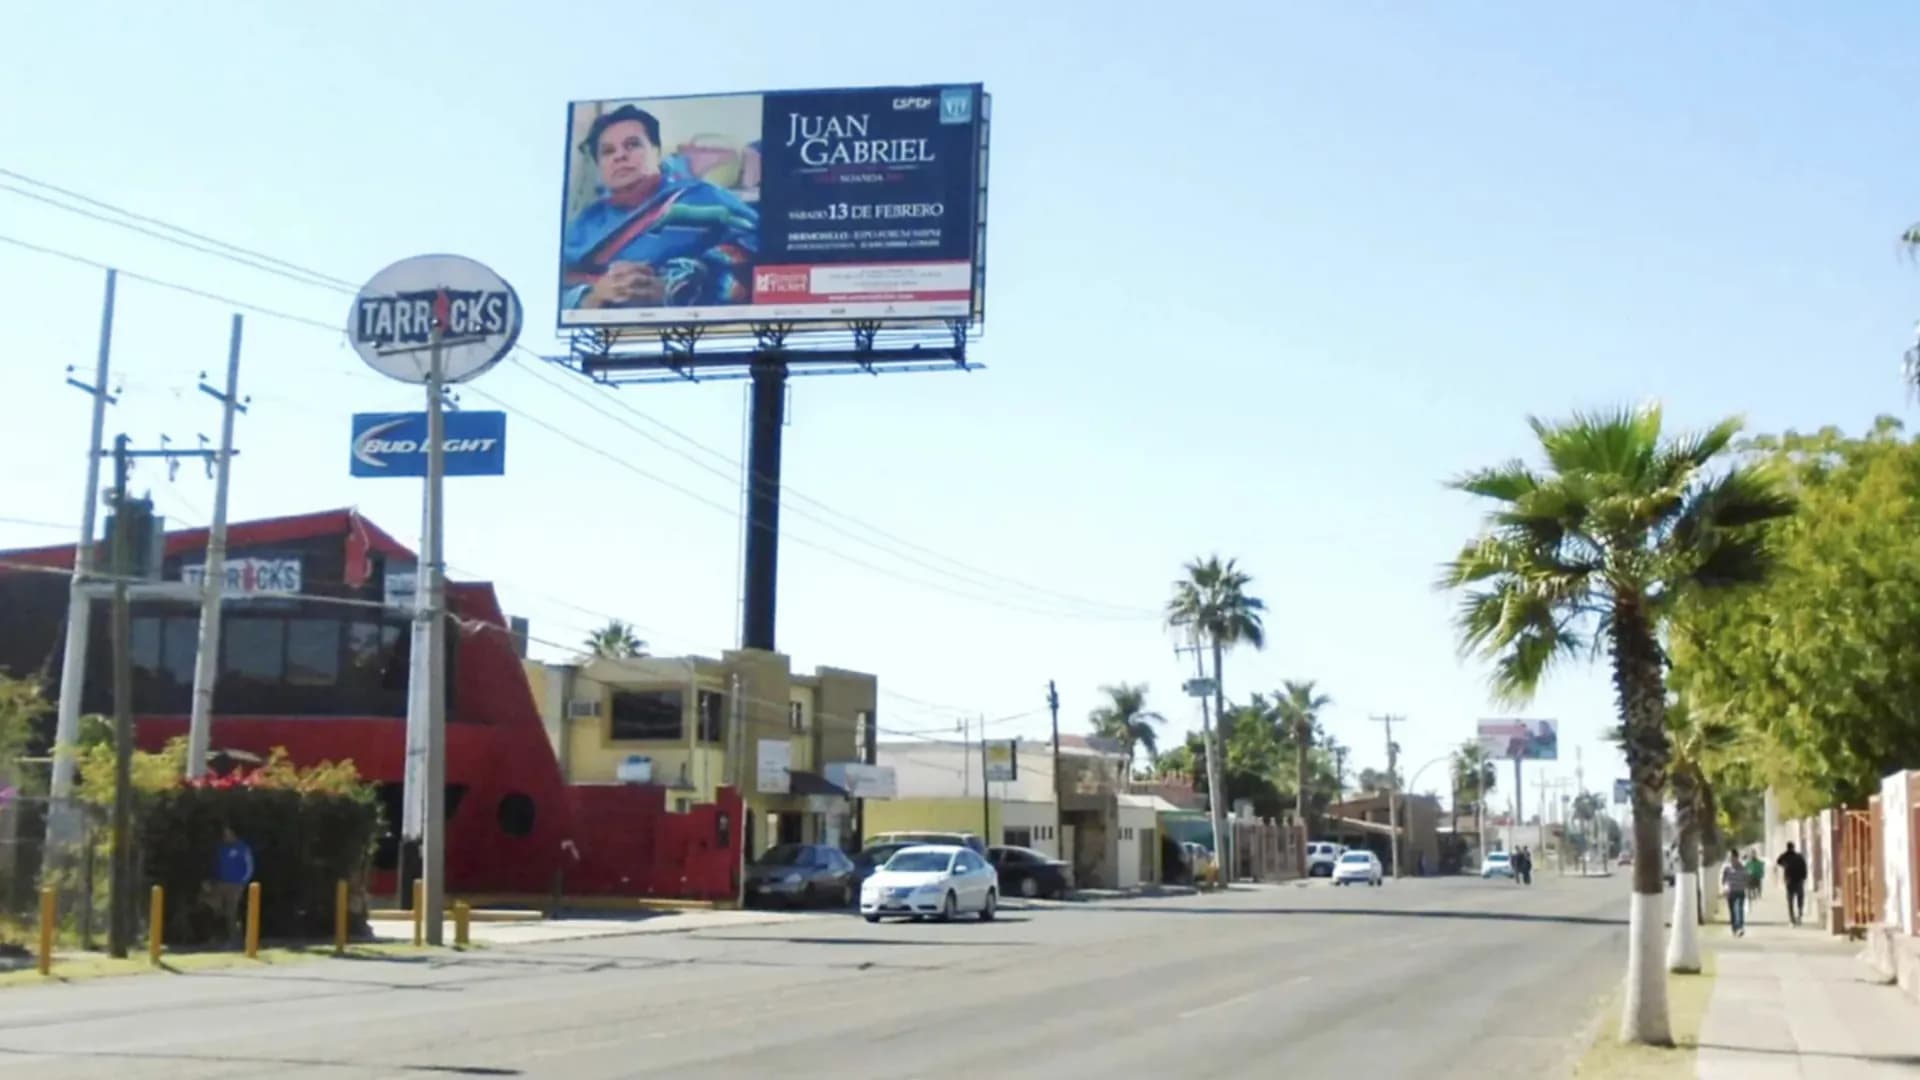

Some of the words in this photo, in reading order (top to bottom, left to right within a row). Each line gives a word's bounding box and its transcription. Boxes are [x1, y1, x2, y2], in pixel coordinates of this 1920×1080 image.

[786, 112, 870, 147] JUAN
[801, 138, 936, 166] GABRIEL
[828, 203, 848, 220] 13
[851, 204, 873, 219] DE
[875, 202, 944, 219] FEBRERO
[363, 438, 417, 454] BUD
[418, 437, 497, 454] LGHT
[188, 561, 298, 591] TRCKS
